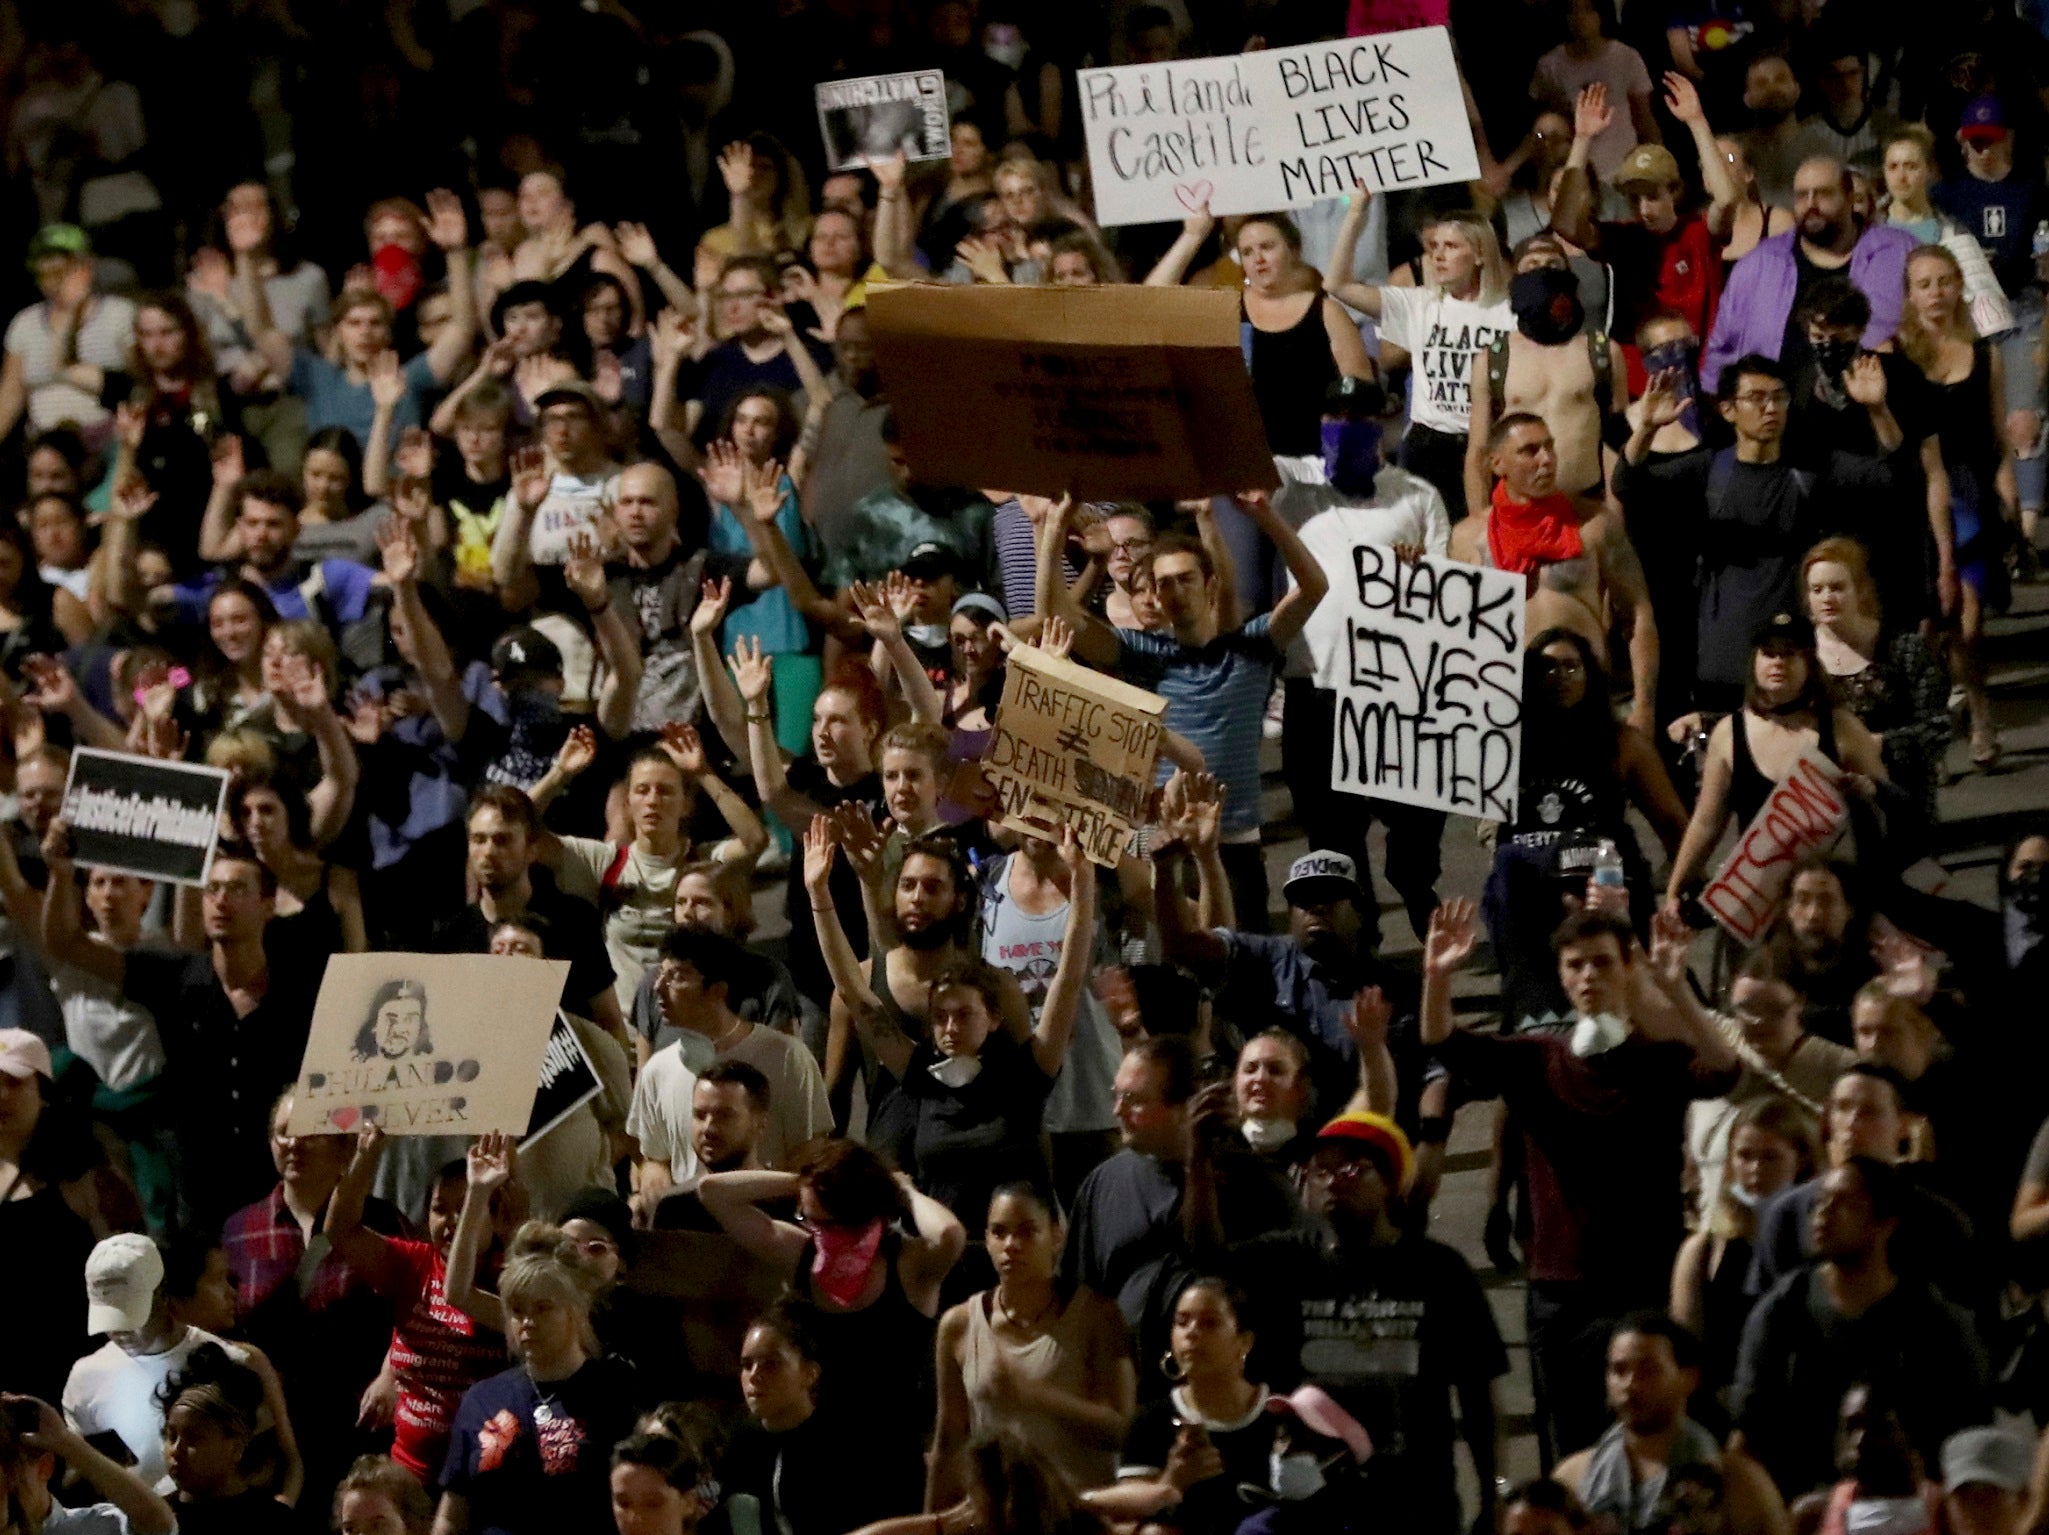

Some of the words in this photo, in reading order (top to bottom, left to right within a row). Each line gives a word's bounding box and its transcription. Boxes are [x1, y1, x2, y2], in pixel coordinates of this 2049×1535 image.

[1279, 44, 1408, 98] BLACK
[1109, 117, 1265, 181] Castile
[1297, 94, 1410, 148] LIVES
[1280, 140, 1450, 200] MATTER
[1423, 351, 1477, 379] LIV
[1353, 545, 1517, 653] BLACK
[1347, 617, 1522, 729] LIVES
[1010, 660, 1106, 738] TRAFFIC
[1108, 712, 1159, 760] STOP
[989, 728, 1067, 792] DEATH
[1340, 697, 1518, 825] MATTER
[1704, 757, 1842, 939] DISARM
[305, 1058, 481, 1099] PHILANDO
